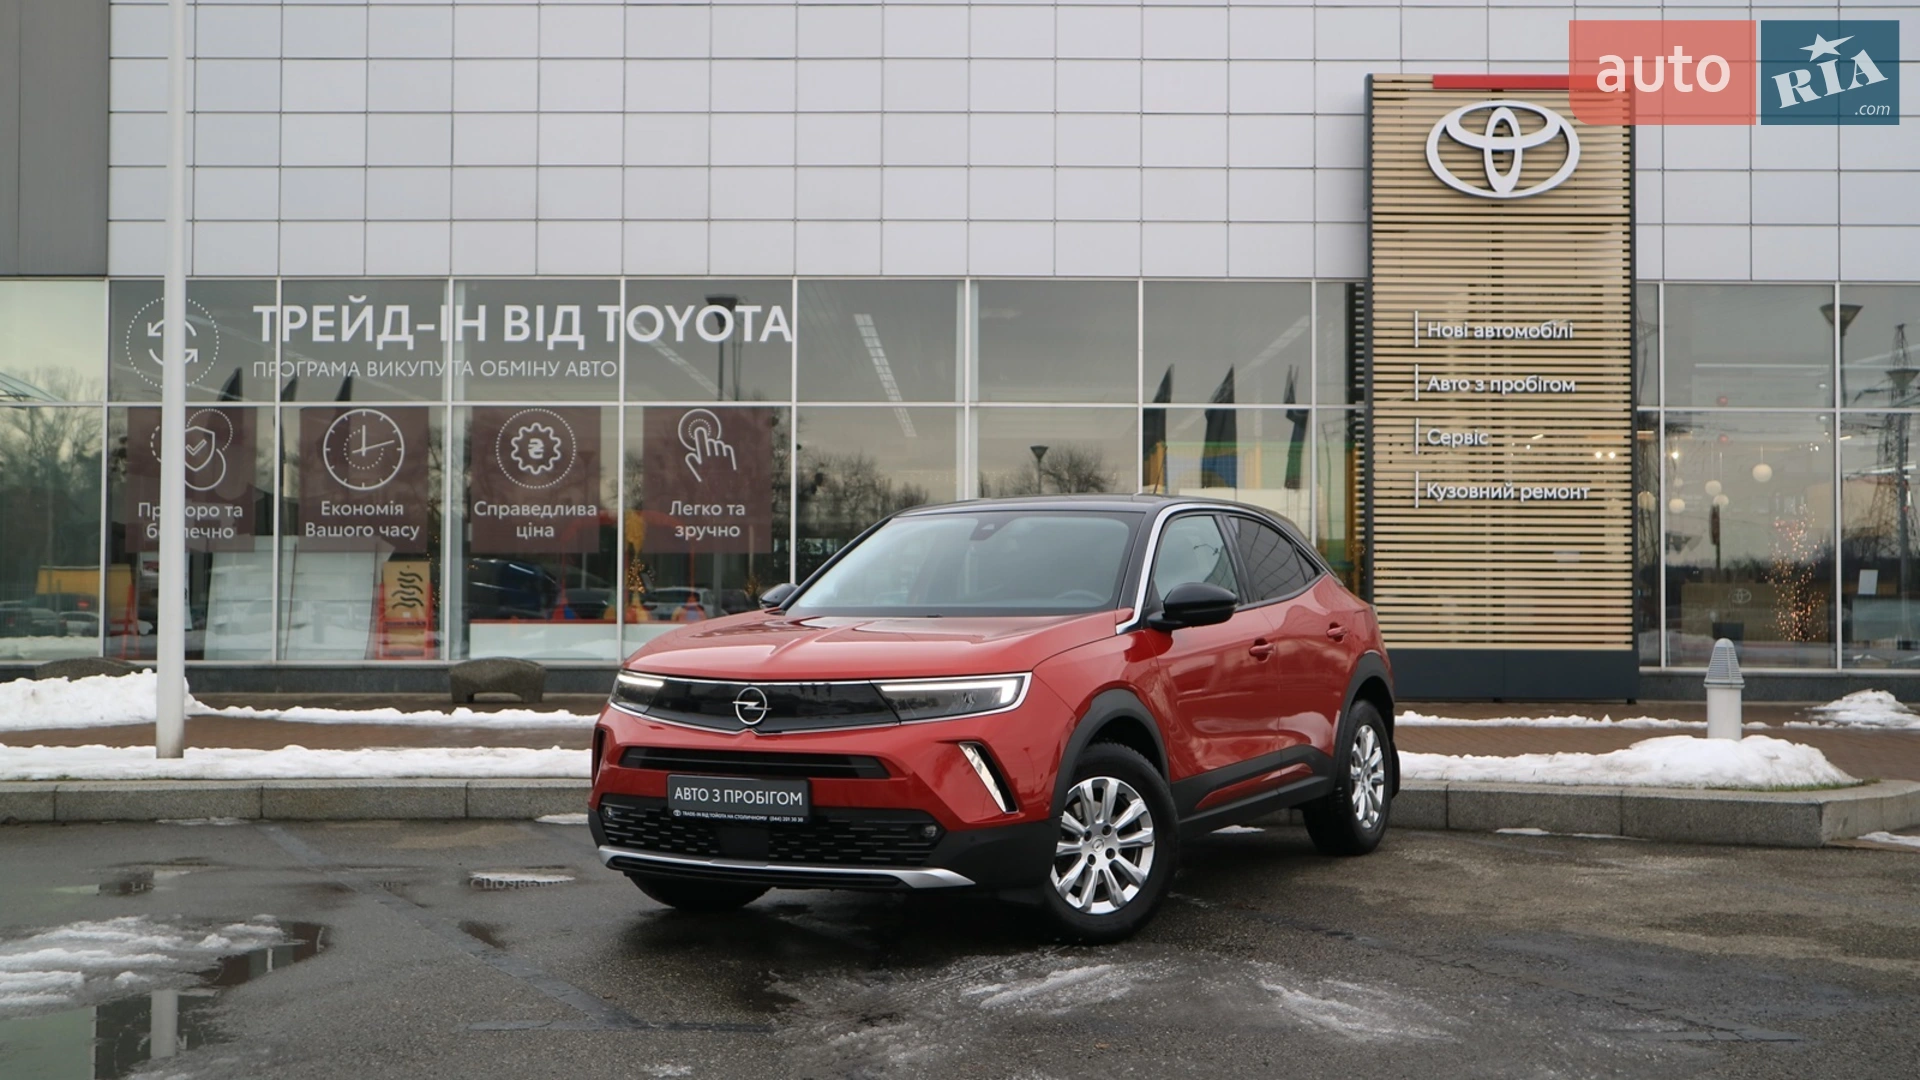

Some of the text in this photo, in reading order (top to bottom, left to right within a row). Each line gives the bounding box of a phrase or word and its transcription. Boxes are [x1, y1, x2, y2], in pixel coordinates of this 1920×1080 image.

[253, 295, 793, 351] ТРЕЙД-ІН ВІД TOYOTA
[1427, 320, 1574, 339] Нові автомобілі
[253, 360, 618, 377] ПРОГРАМА ВИКУПУ ТА ОБМІНУ АВТО
[1427, 375, 1575, 395] Авто з пробігом
[1427, 428, 1489, 448] Сервіс
[1427, 482, 1590, 502] Кузовний ремонт
[138, 502, 244, 521] Проро та
[321, 500, 404, 516] Економія
[474, 501, 598, 519] Справедлива
[669, 500, 746, 516] Легко та
[305, 522, 420, 541] Вашого часу
[516, 522, 554, 539] ціна
[674, 525, 741, 541] зручно
[674, 786, 803, 806] АВТО З ПРОБІГОМ
